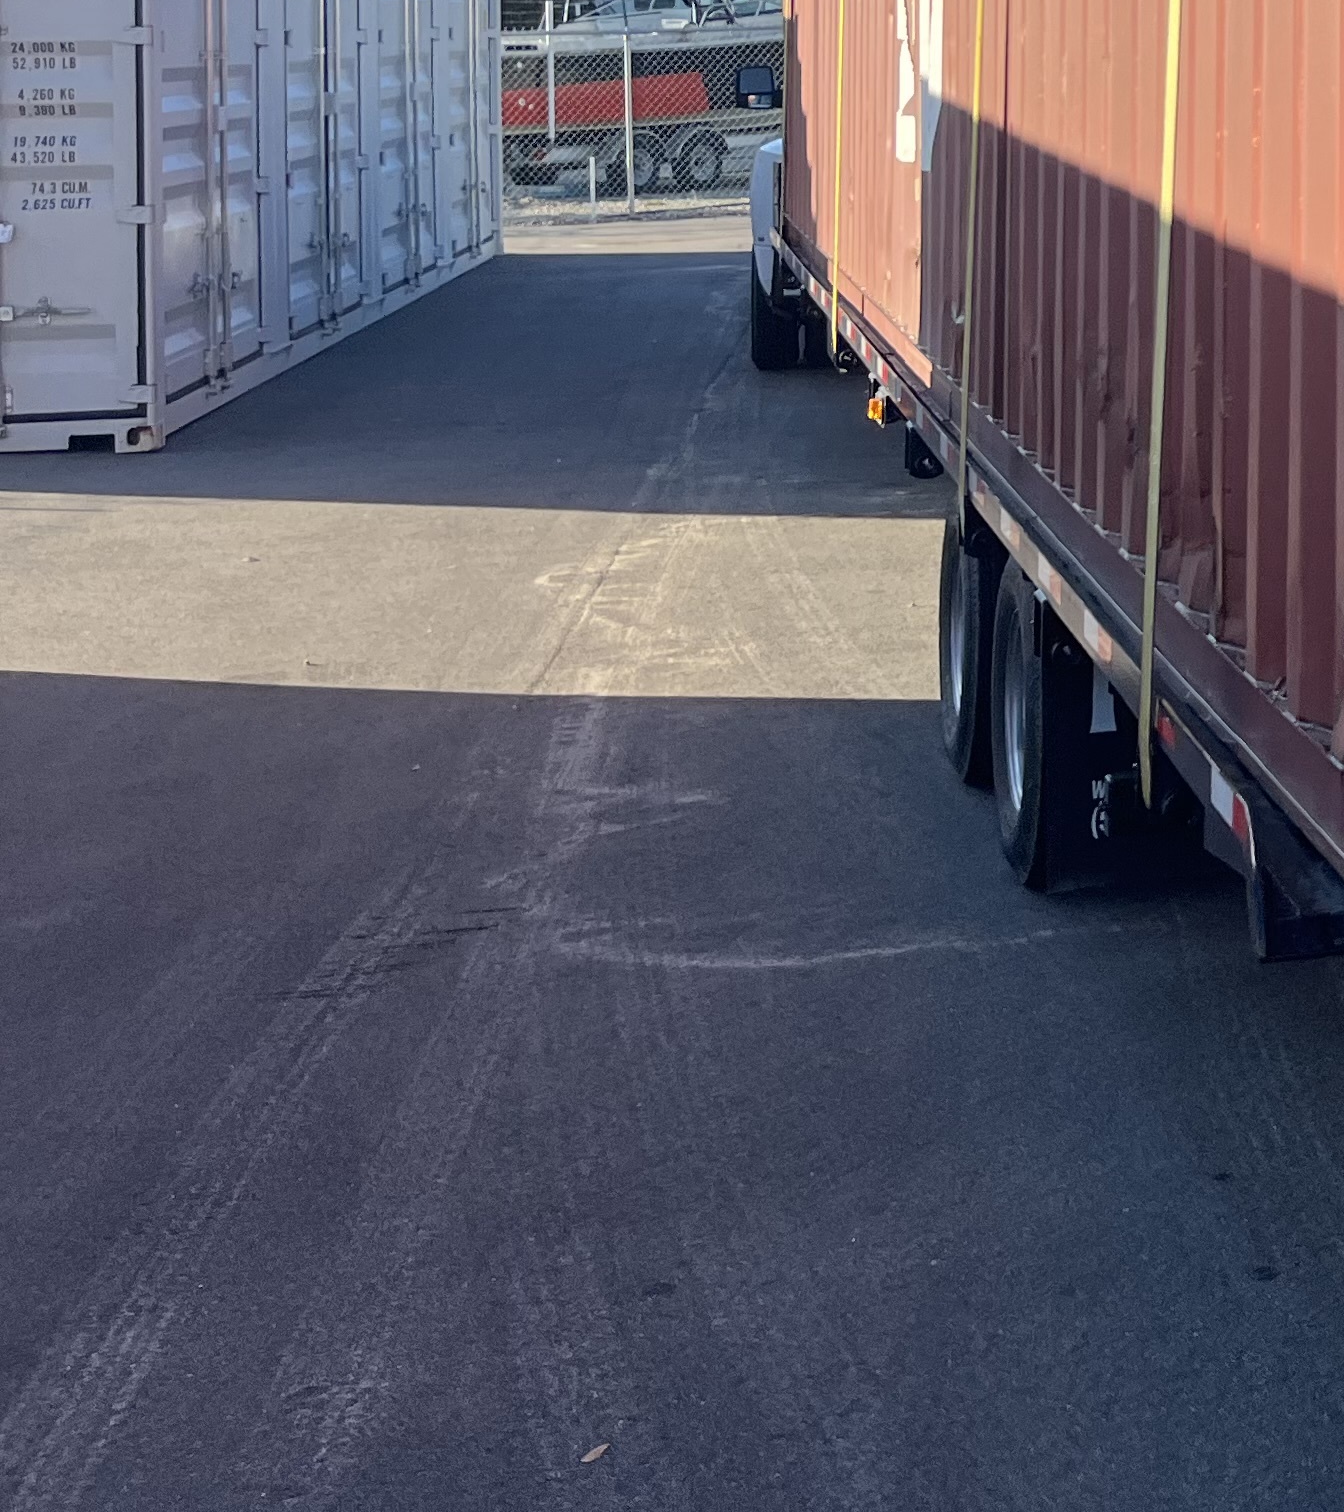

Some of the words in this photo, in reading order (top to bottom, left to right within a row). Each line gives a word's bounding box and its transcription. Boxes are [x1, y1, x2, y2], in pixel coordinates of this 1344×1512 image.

[60, 42, 76, 53] KG
[62, 57, 76, 69] LB
[60, 88, 75, 100] KG
[62, 104, 76, 116] LB
[61, 135, 77, 147] KG
[61, 151, 76, 163] LB
